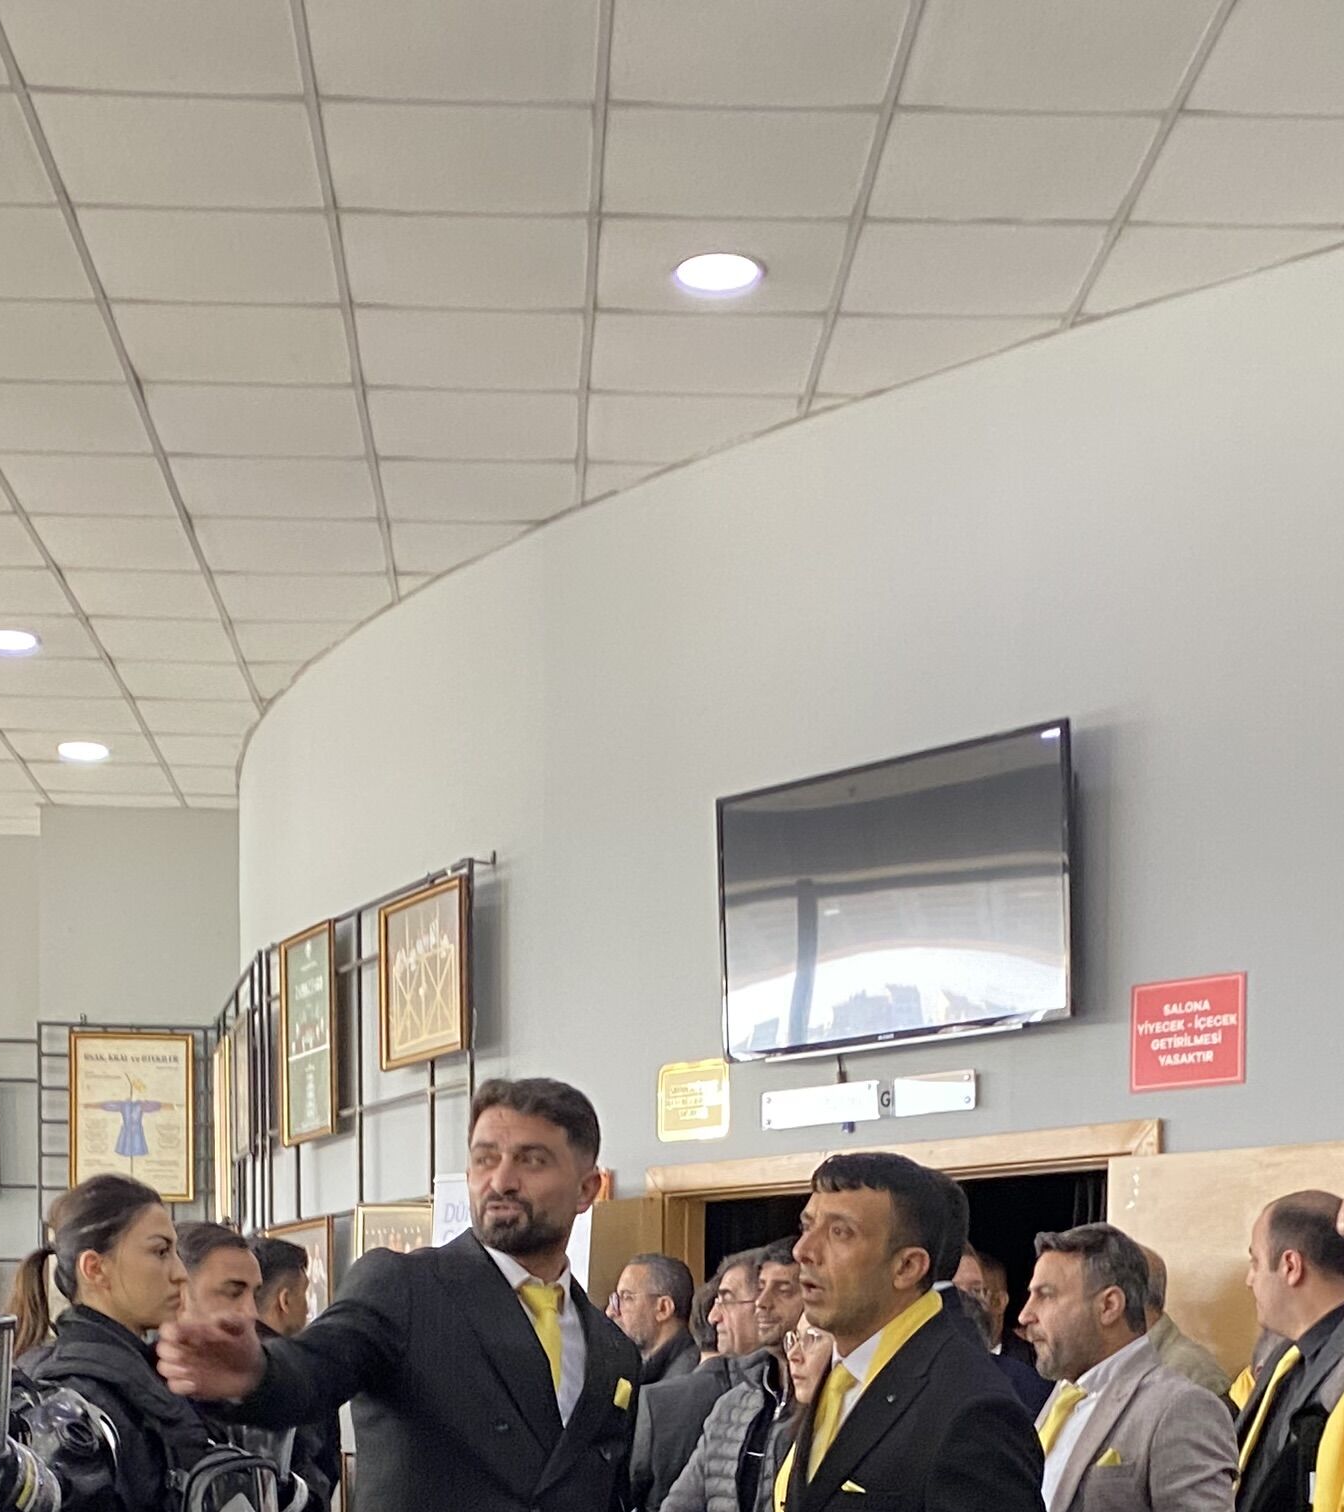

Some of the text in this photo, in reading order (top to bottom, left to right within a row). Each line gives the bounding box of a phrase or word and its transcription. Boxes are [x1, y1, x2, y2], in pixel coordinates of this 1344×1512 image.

[1163, 999, 1211, 1016] SALONA
[1137, 1020, 1185, 1036] YİYECEK
[1194, 1013, 1238, 1031] İÇECEK
[1151, 1028, 1223, 1051] GETİRİLMESİ
[1158, 1050, 1214, 1066] YASAKTIR
